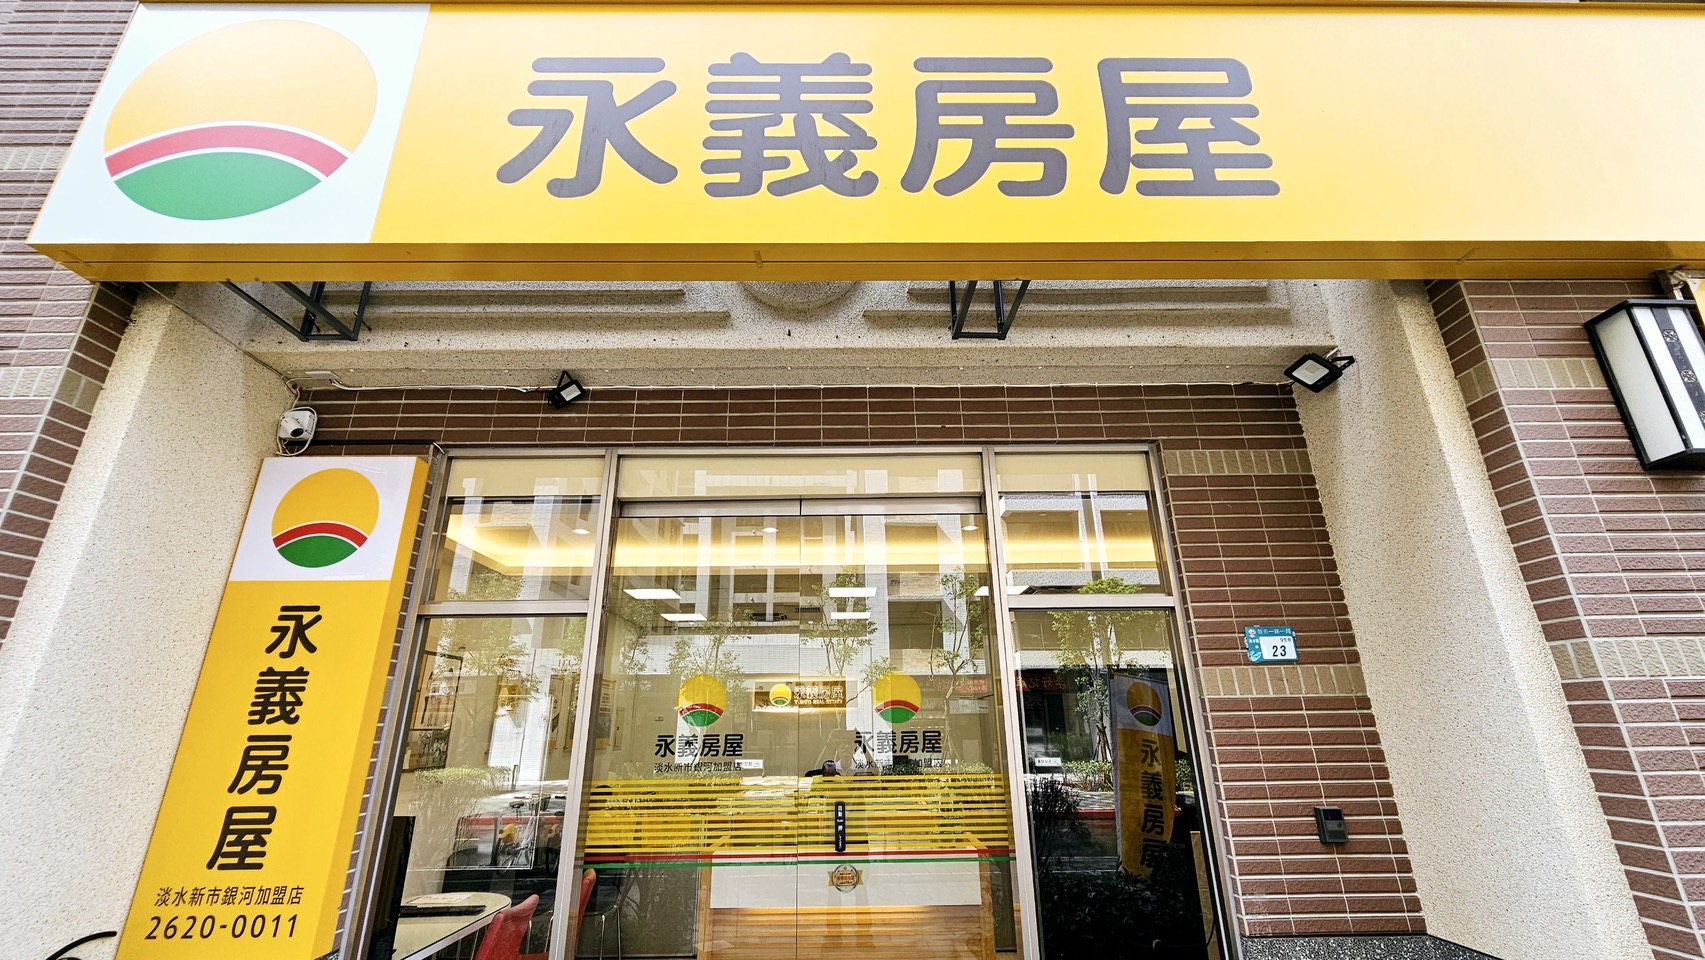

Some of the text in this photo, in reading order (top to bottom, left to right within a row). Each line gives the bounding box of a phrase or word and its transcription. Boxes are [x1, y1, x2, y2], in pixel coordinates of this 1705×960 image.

[497, 52, 1281, 198] 永義房屋
[1273, 646, 1286, 656] 23
[206, 605, 321, 871] 永義房屋
[654, 733, 744, 758] 永義房屋
[854, 730, 943, 754] 永義房屋
[654, 761, 743, 773] 淡水新市銀河加盟店
[154, 885, 305, 907] 淡水新市銀河加盟店
[145, 914, 299, 940] 2620-0011
